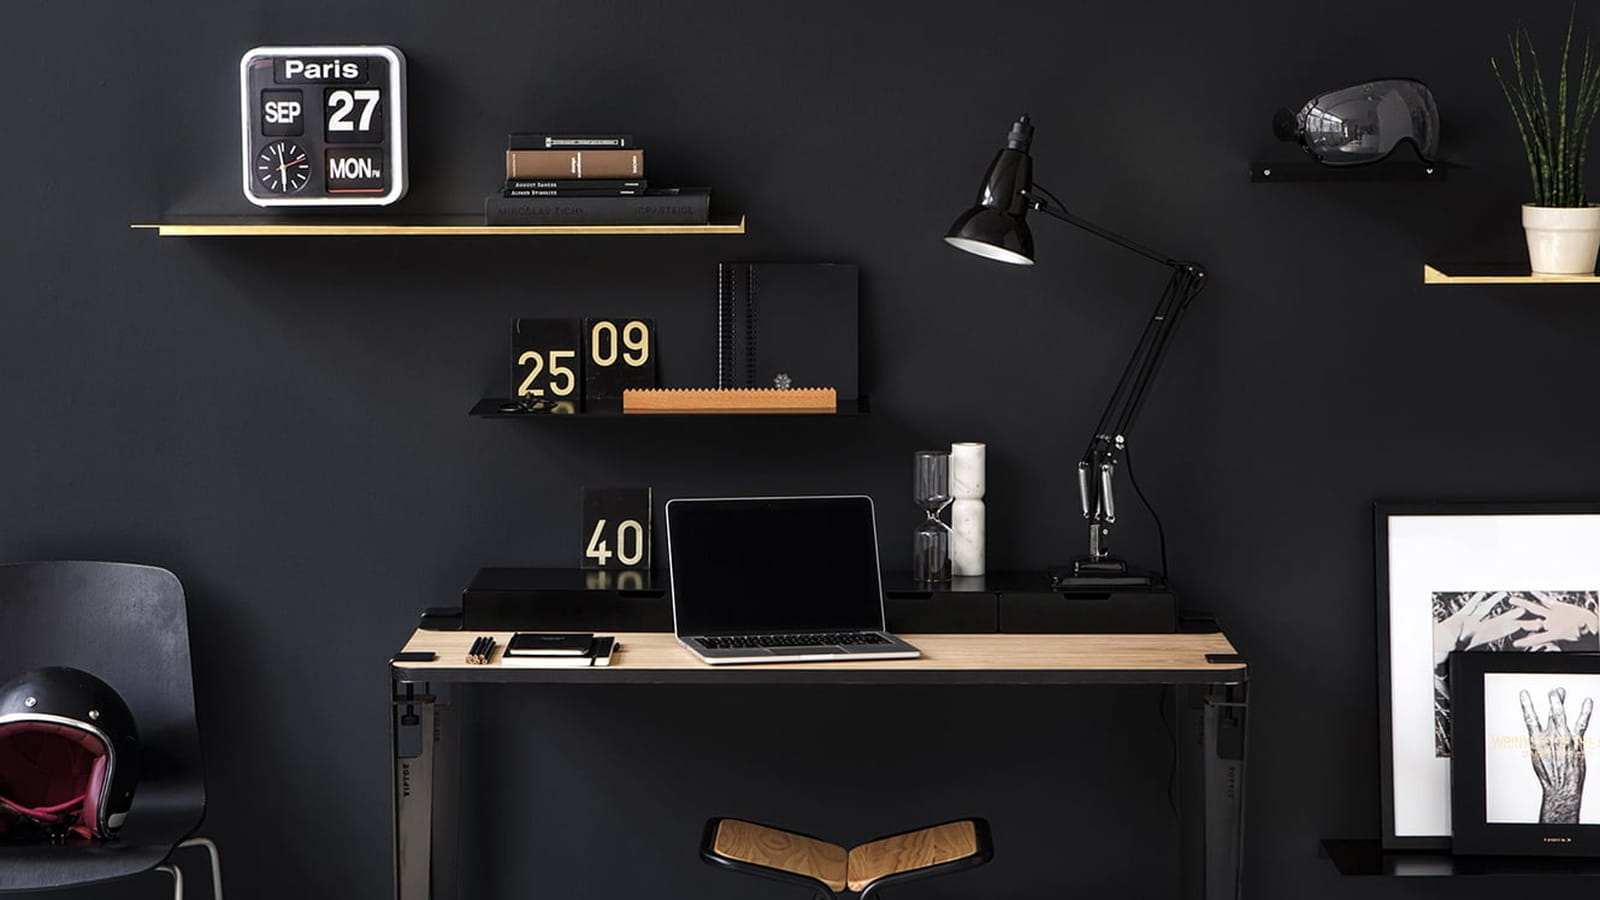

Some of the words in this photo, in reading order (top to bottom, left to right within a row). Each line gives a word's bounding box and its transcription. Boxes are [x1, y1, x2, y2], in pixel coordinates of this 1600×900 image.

[285, 60, 359, 79] Paris
[265, 101, 301, 123] SEP
[328, 89, 380, 132] 27
[330, 158, 372, 179] MON
[592, 321, 649, 367] 09
[518, 350, 575, 396] 25
[586, 519, 643, 566] 40
